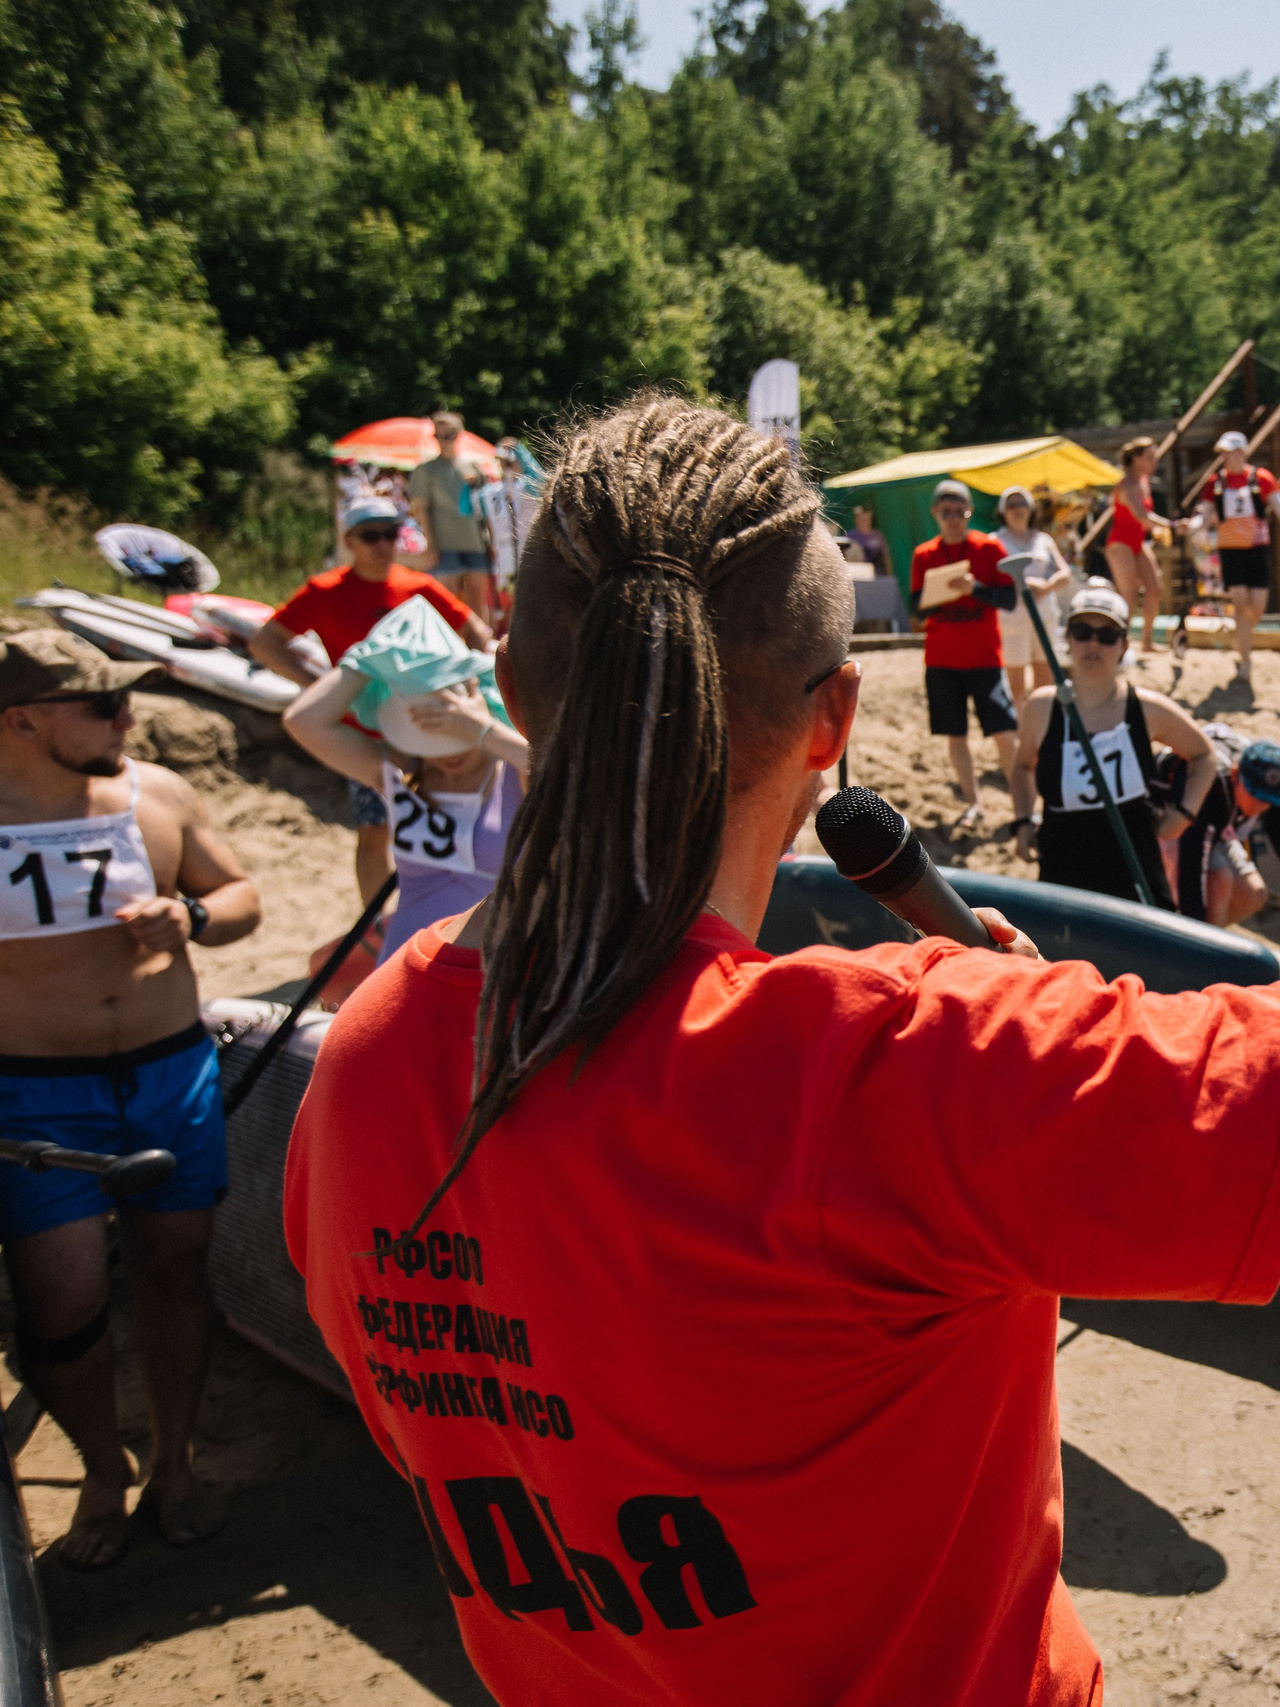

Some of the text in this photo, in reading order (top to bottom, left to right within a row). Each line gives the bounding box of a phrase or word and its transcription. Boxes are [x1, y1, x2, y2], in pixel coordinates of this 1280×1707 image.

[1078, 749, 1124, 804] 37
[393, 791, 457, 860] 29
[9, 848, 113, 926] 17
[357, 1294, 534, 1368] ФЕДЕРАЦИЯ
[506, 1381, 576, 1441] НСО
